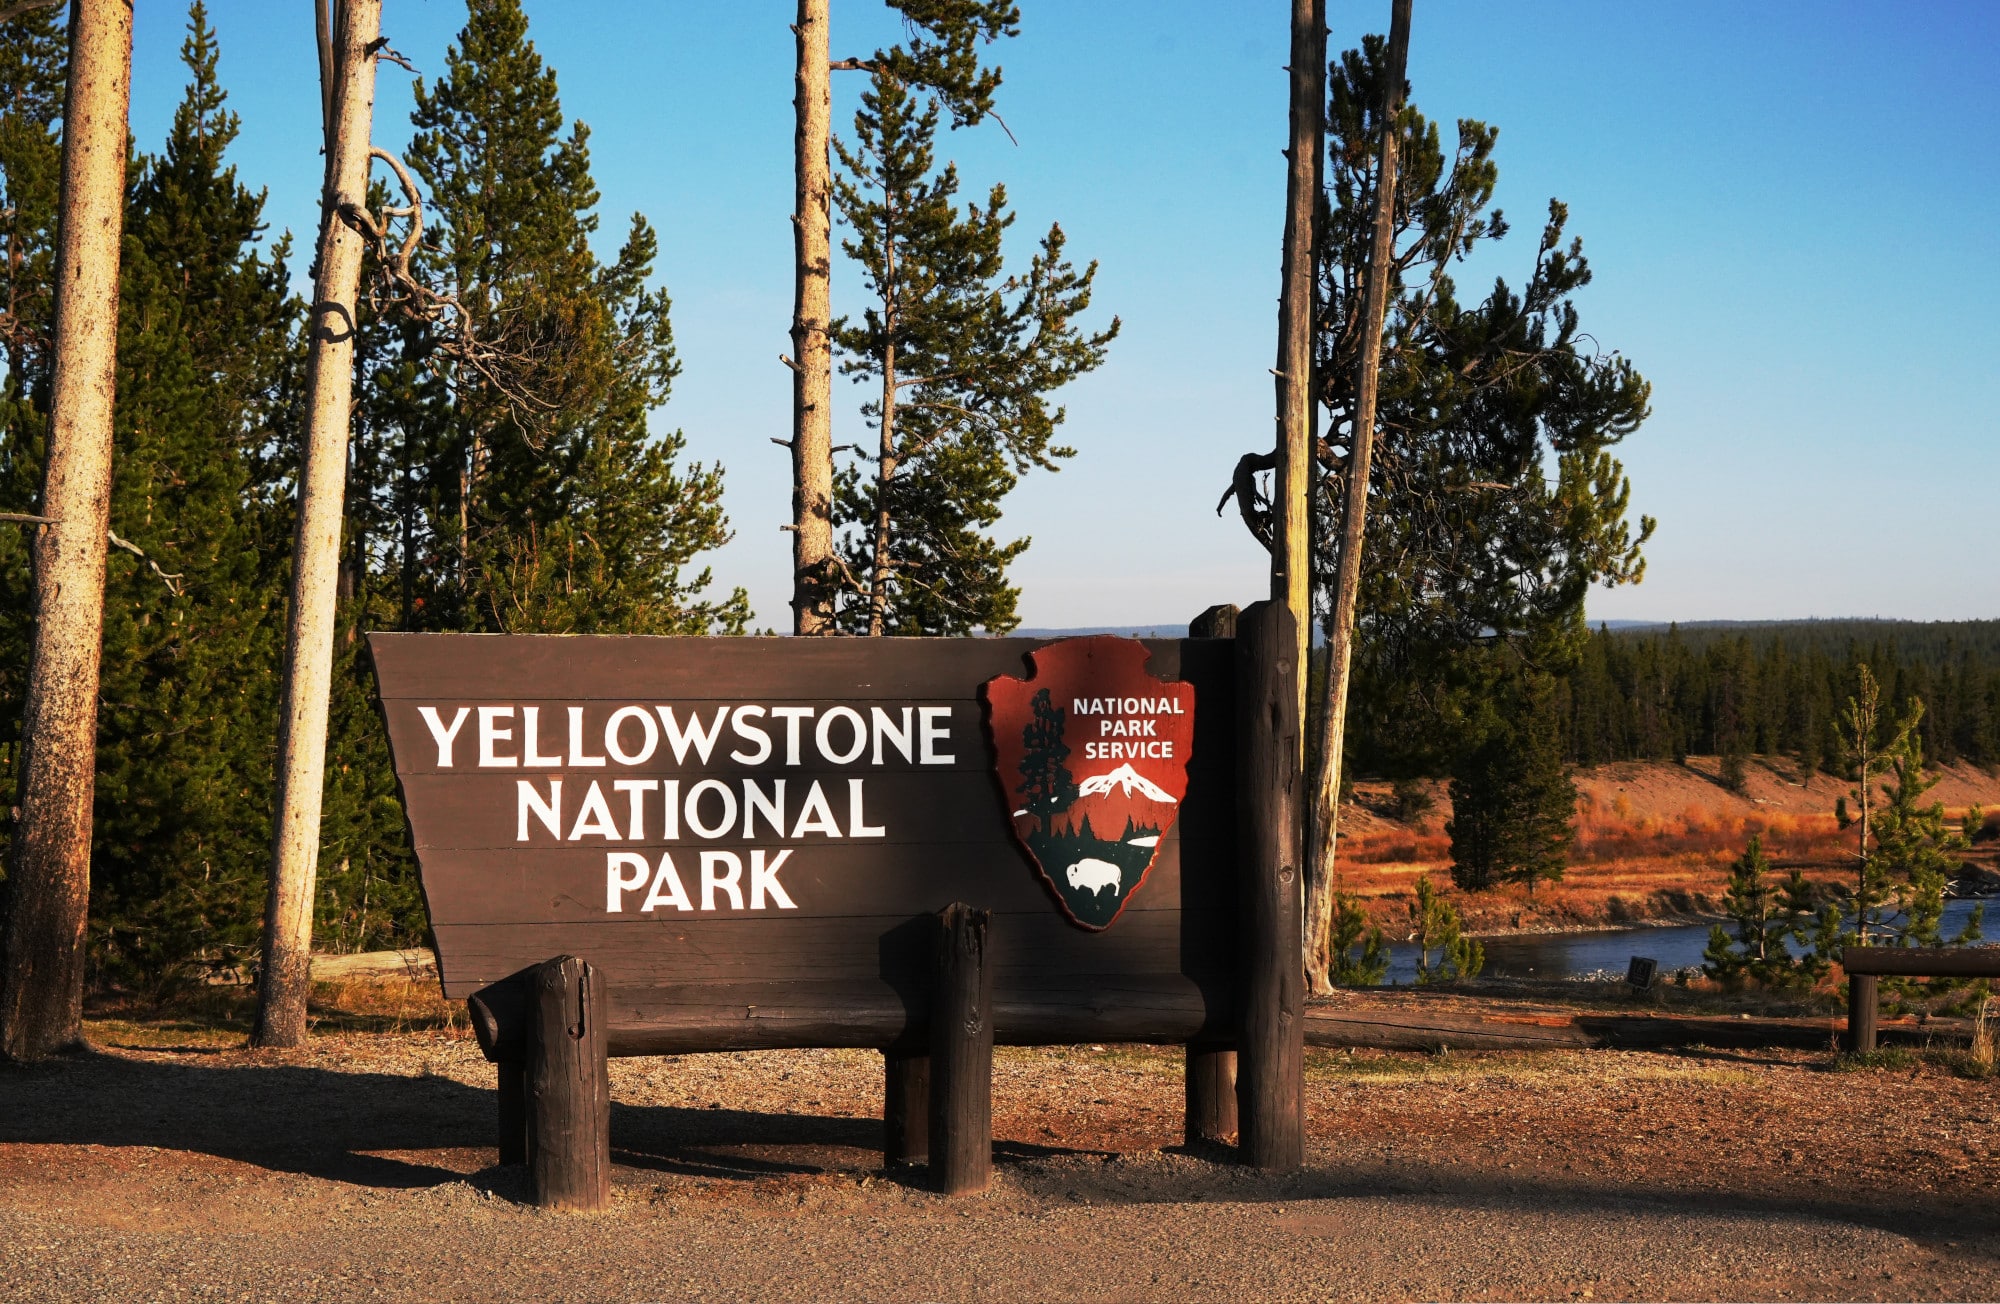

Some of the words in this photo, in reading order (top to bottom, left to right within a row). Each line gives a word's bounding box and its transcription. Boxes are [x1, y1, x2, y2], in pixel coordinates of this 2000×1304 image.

[1073, 697, 1184, 714] NATIONAL
[416, 705, 956, 767] YELLOWSTONE
[1100, 719, 1157, 736] PARK
[1085, 741, 1173, 759] SERVICE
[515, 777, 886, 842] NATIONAL
[605, 849, 799, 913] PARK
